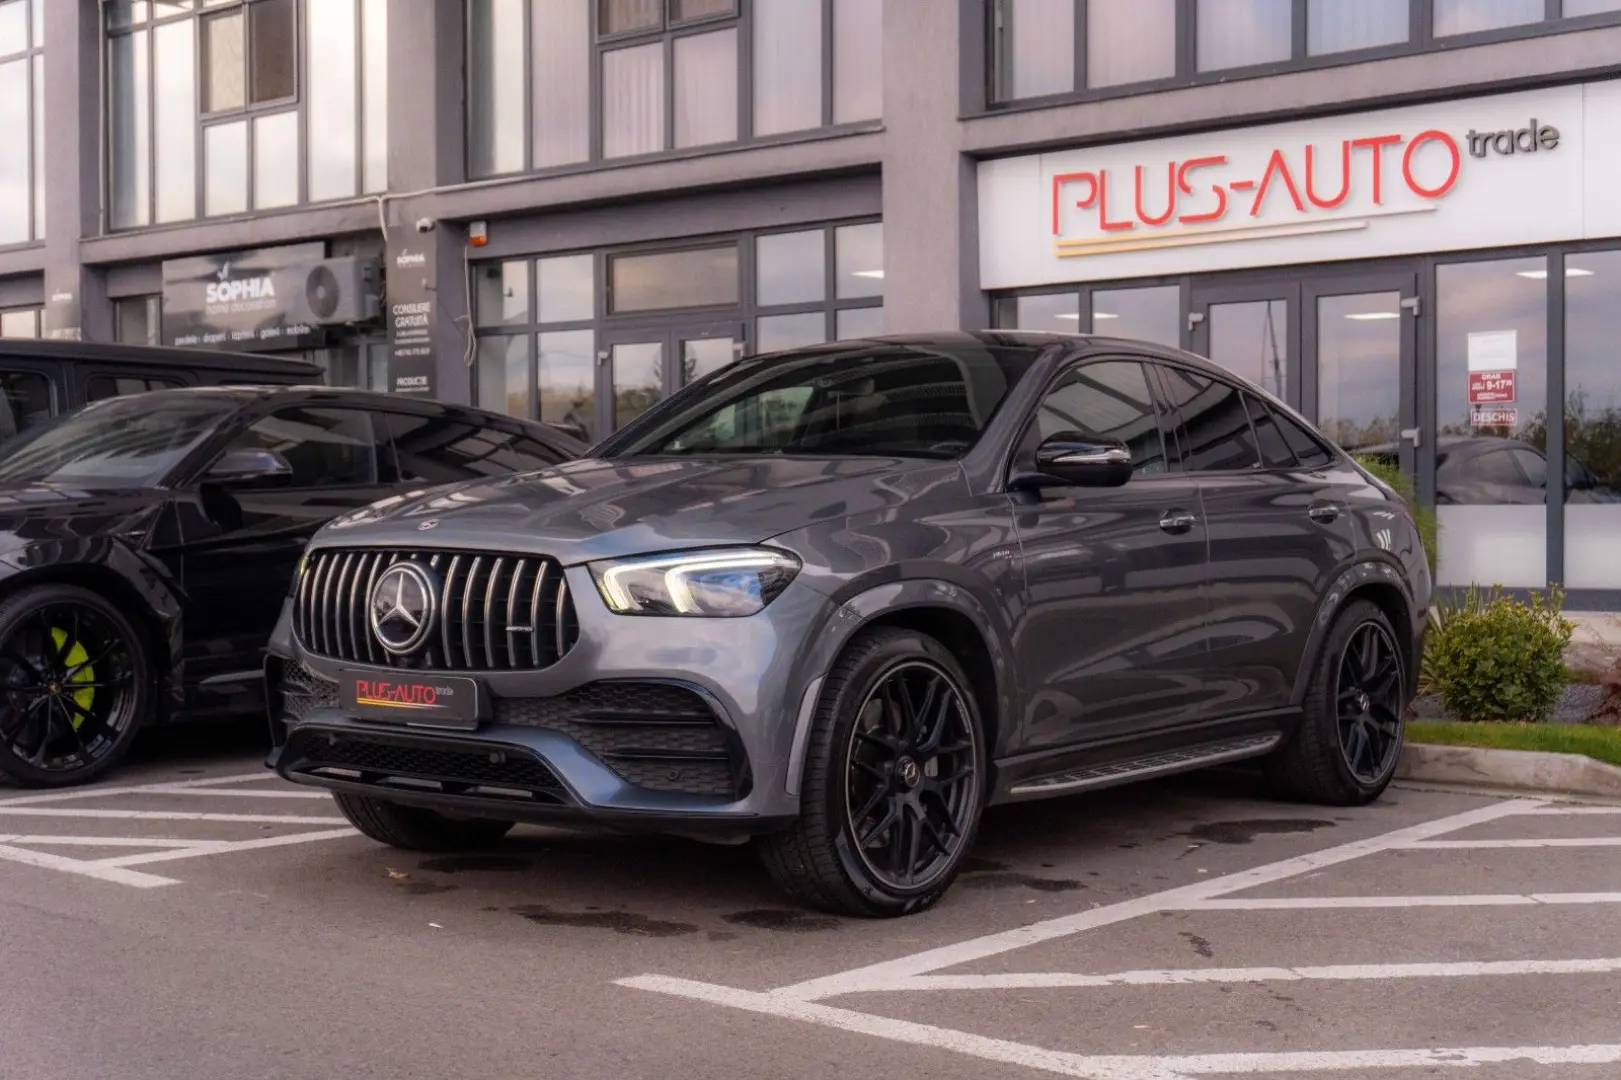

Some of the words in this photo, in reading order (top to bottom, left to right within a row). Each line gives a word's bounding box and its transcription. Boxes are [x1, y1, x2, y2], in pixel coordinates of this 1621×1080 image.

[1053, 129, 1461, 235] PLUS-AUTO
[1466, 118, 1560, 157] trade
[206, 277, 275, 303] SOPHIA
[1473, 411, 1515, 422] DESCHIS
